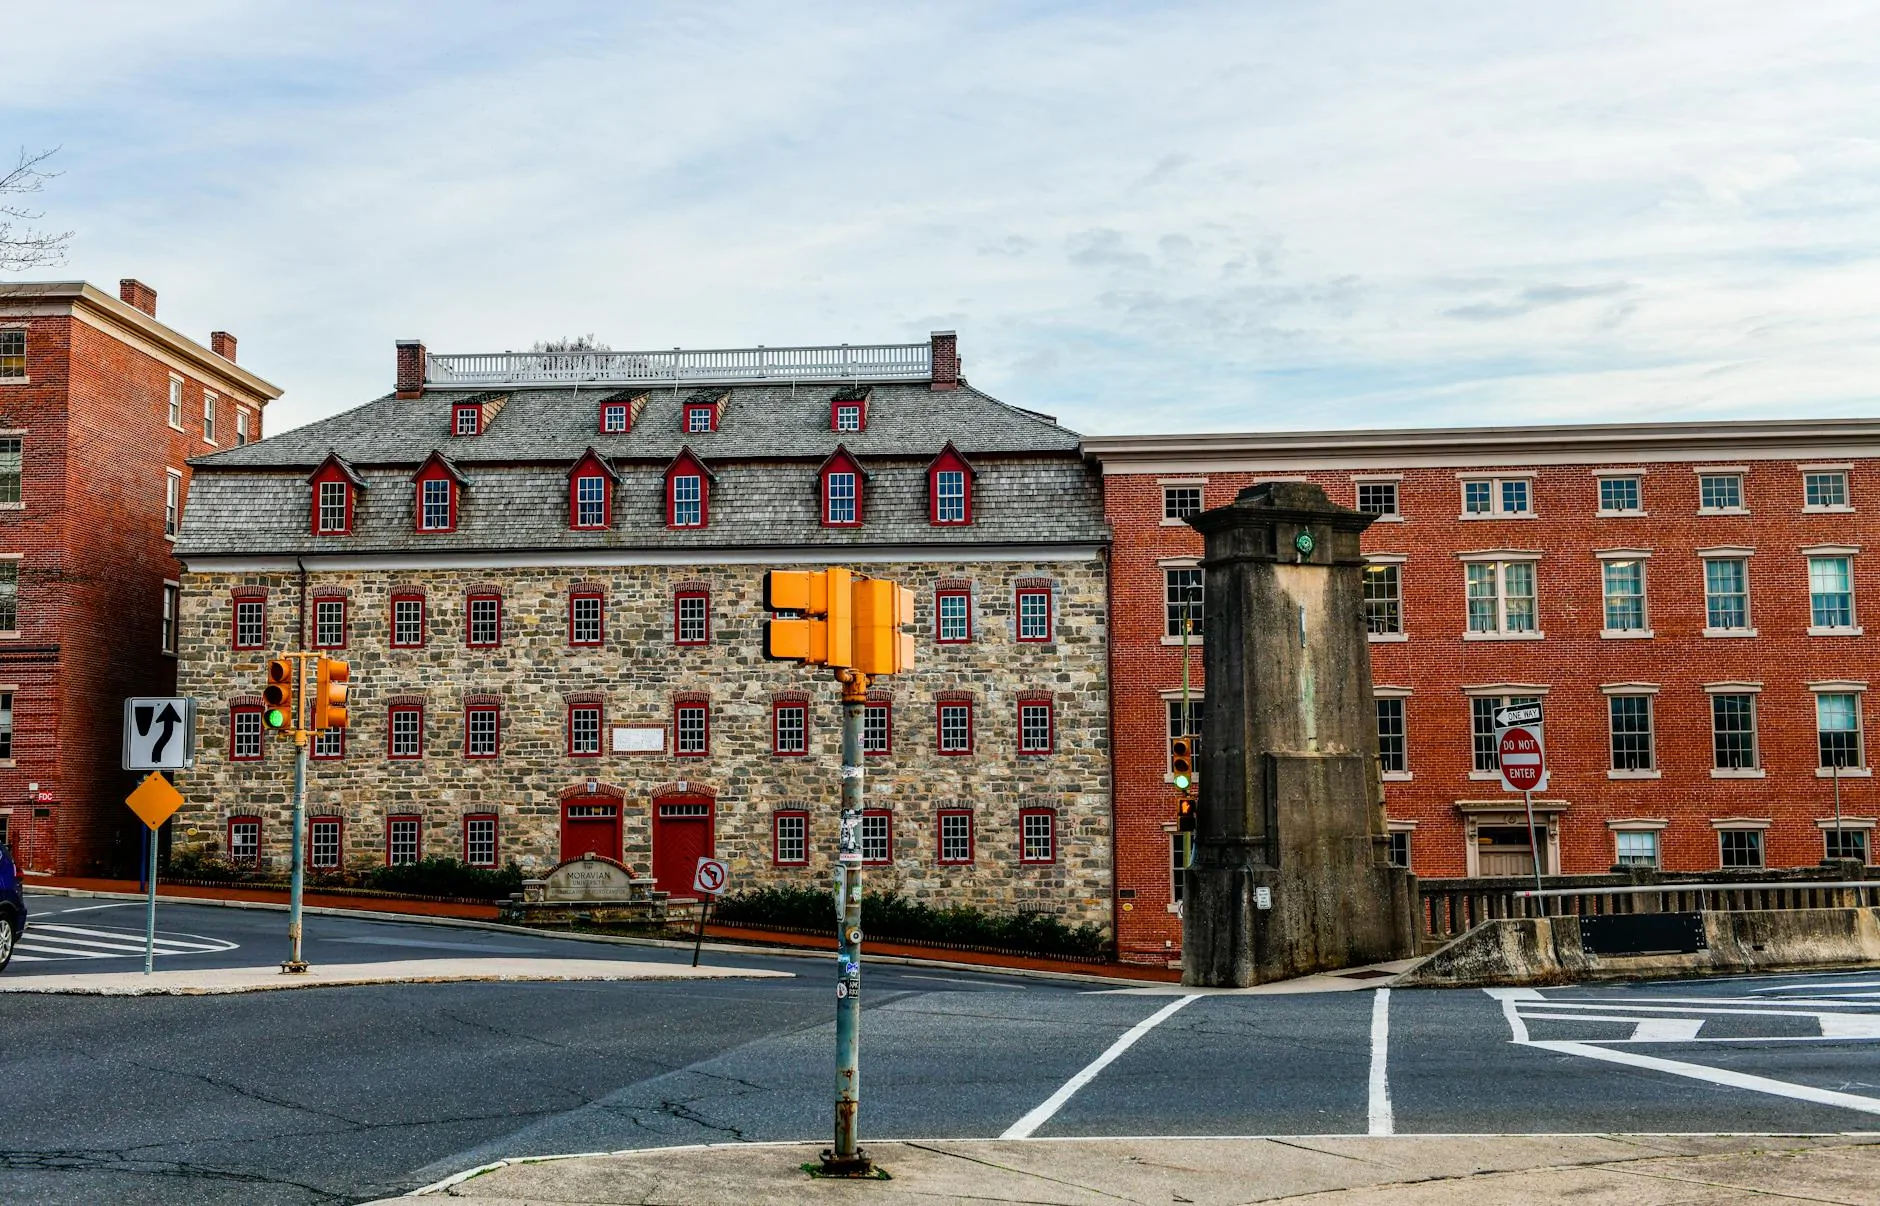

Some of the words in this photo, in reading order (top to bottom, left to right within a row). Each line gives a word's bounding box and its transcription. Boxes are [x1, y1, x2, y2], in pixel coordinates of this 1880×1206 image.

[1508, 712, 1521, 720] ONE
[1524, 710, 1537, 718] WAY
[1503, 741, 1514, 750] DO
[1518, 740, 1534, 750] NOT
[1510, 769, 1535, 778] ENTER
